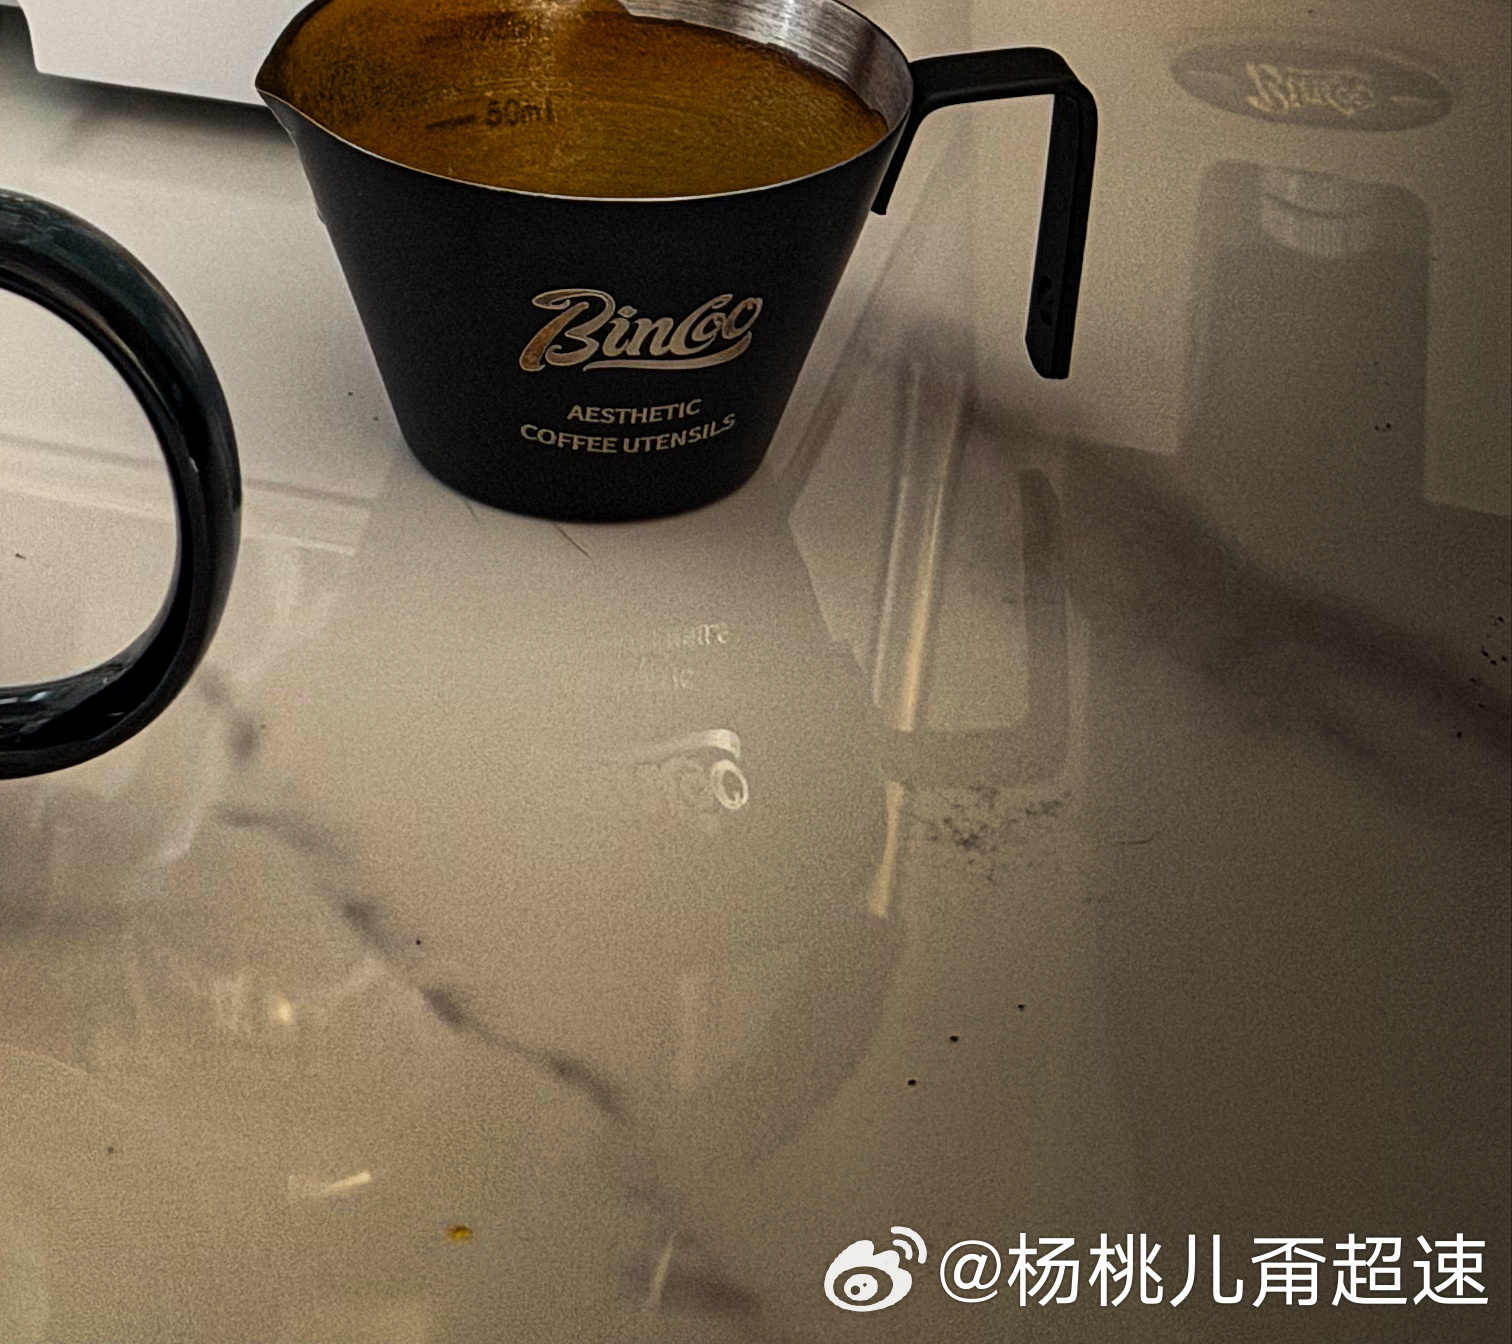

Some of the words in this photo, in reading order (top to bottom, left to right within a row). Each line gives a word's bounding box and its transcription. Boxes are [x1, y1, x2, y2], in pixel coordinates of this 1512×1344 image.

[567, 398, 703, 425] AESTHETIC
[520, 423, 618, 454] COFFEE
[622, 413, 736, 454] UTENSILS
